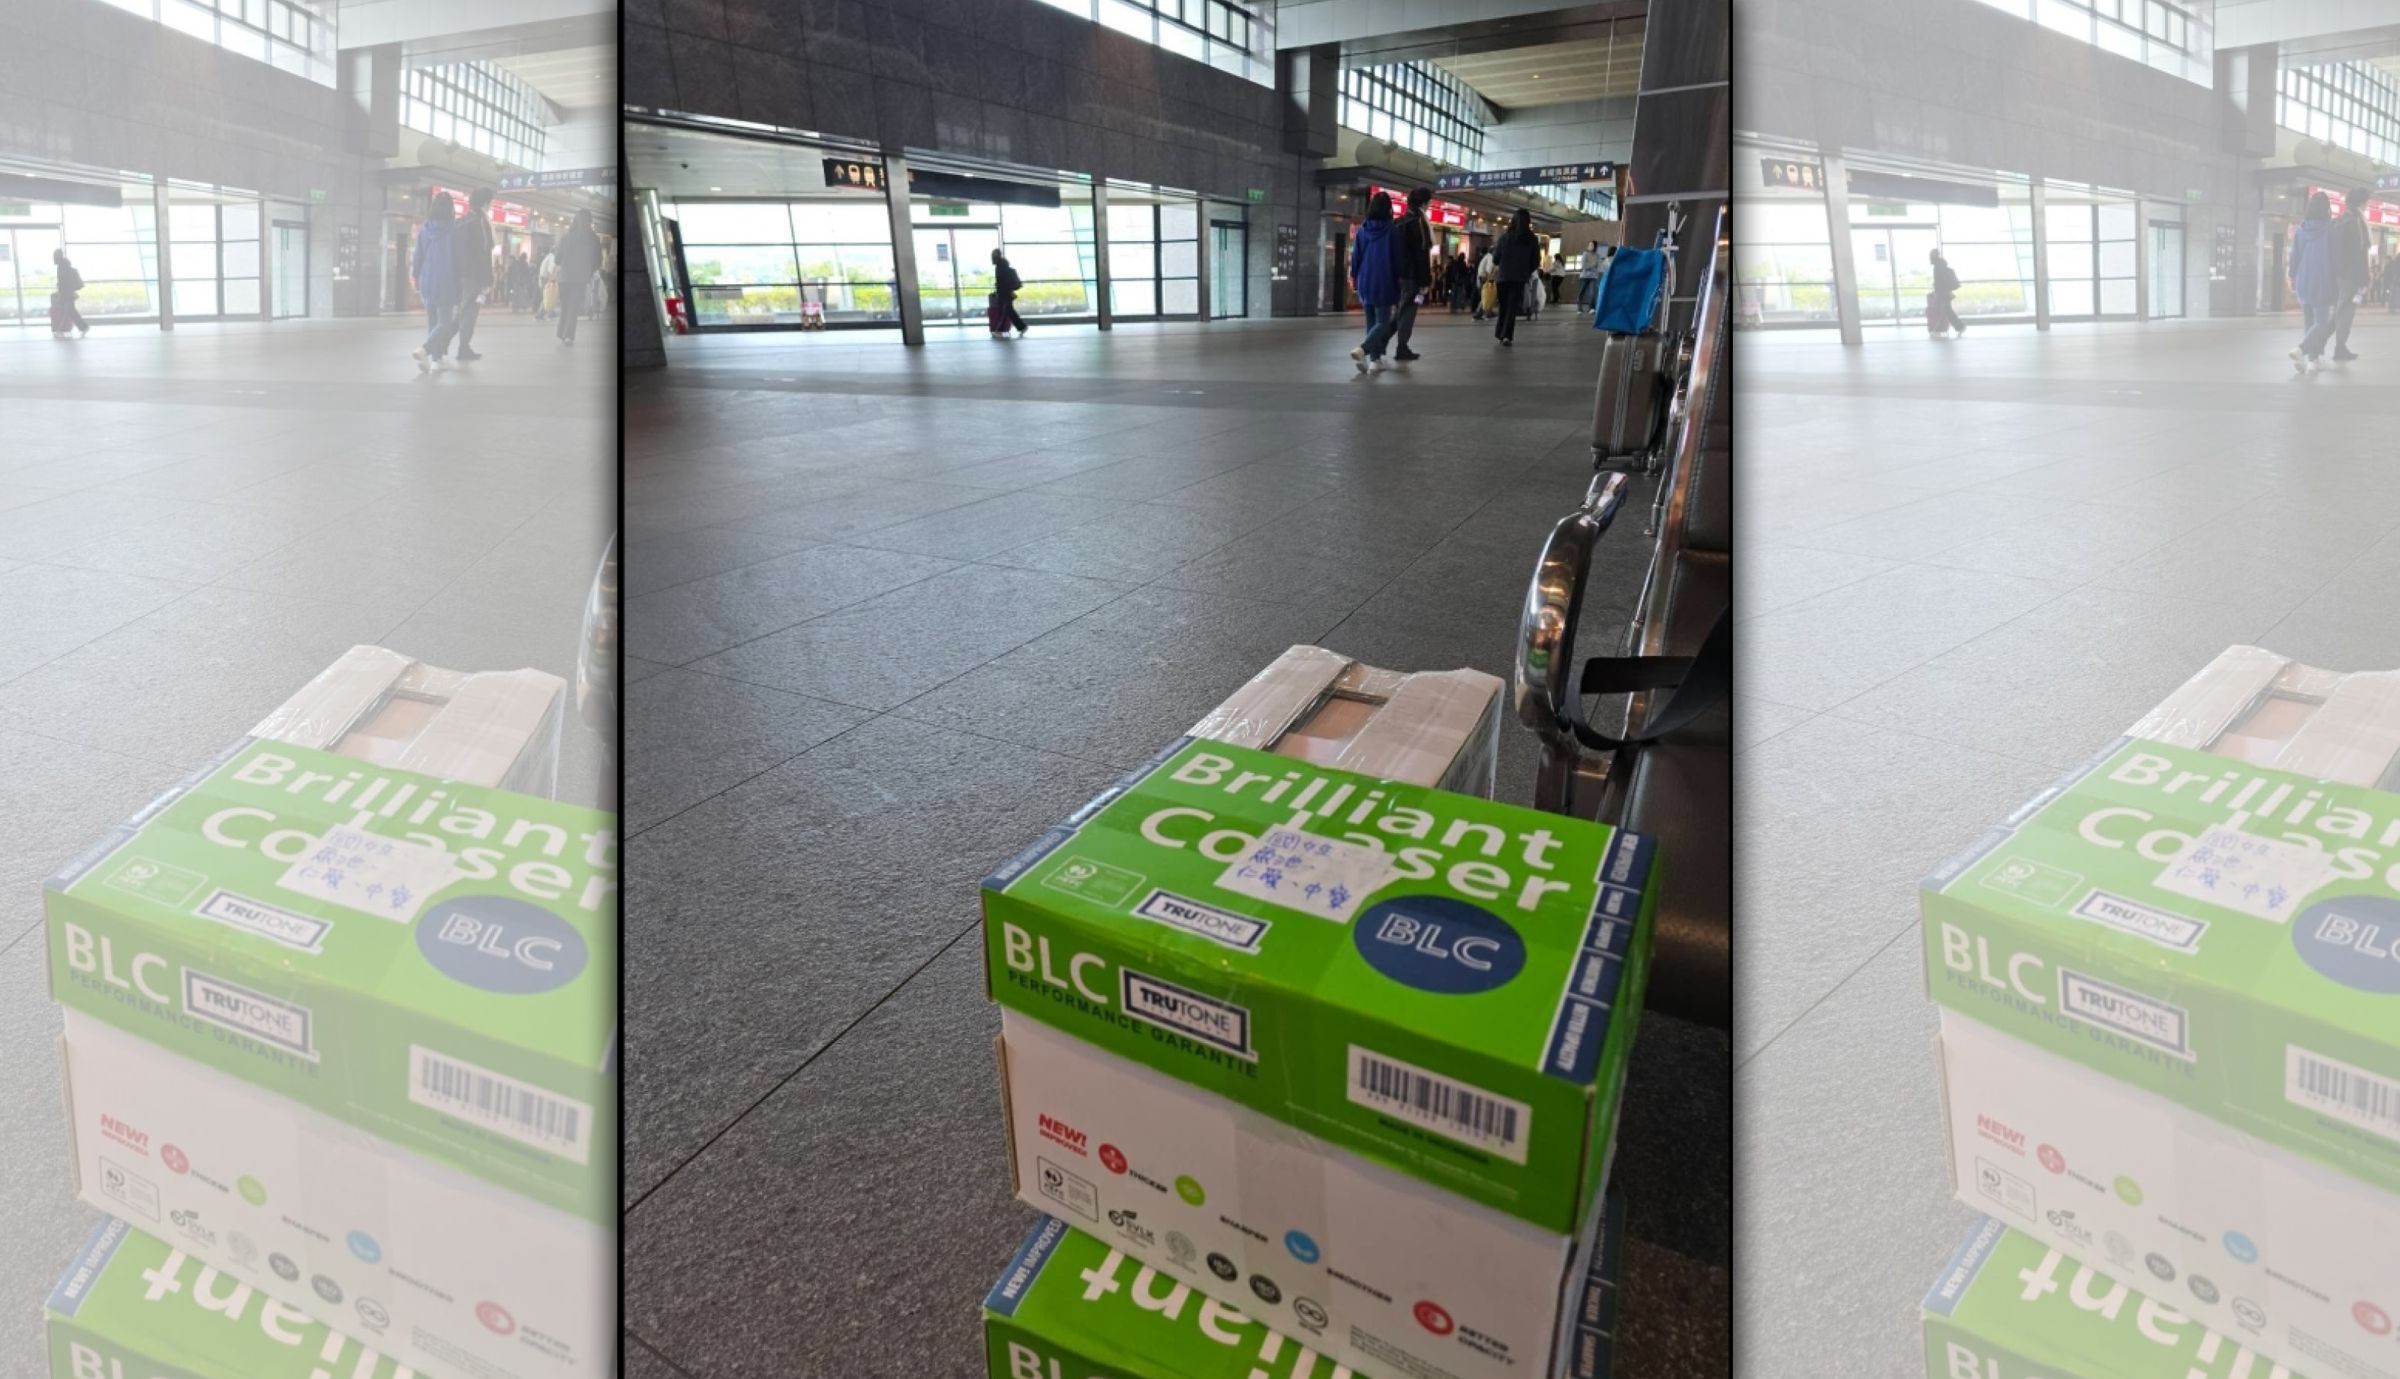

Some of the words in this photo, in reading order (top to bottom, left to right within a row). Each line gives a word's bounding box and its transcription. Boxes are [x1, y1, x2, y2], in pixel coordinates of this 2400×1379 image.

[1170, 752, 1563, 871] Brilliant
[2108, 752, 2400, 847] Brillia
[225, 901, 309, 936] TRUTONE
[1163, 901, 1247, 936] TRUTONE
[1377, 911, 1500, 971] BLC
[2101, 901, 2185, 936] TRUTONE
[2315, 911, 2400, 962] BL
[65, 920, 170, 1004] BLC
[1003, 920, 1108, 1004] BLC
[1941, 920, 2046, 1004] BLC
[70, 969, 204, 1034] PERFORMANCE
[214, 1029, 321, 1078] GARANTIE
[201, 986, 293, 1033] TRUTONE
[1008, 969, 1142, 1034] PERFORMANCE
[1152, 1029, 1259, 1078] GARANTIE
[1139, 986, 1231, 1033] TRUTONE
[1946, 969, 2080, 1034] PERFORMANCE
[2090, 1029, 2197, 1078] GARANTIE
[2077, 986, 2169, 1033] TRUTONE
[1039, 1113, 1088, 1147] NEW!
